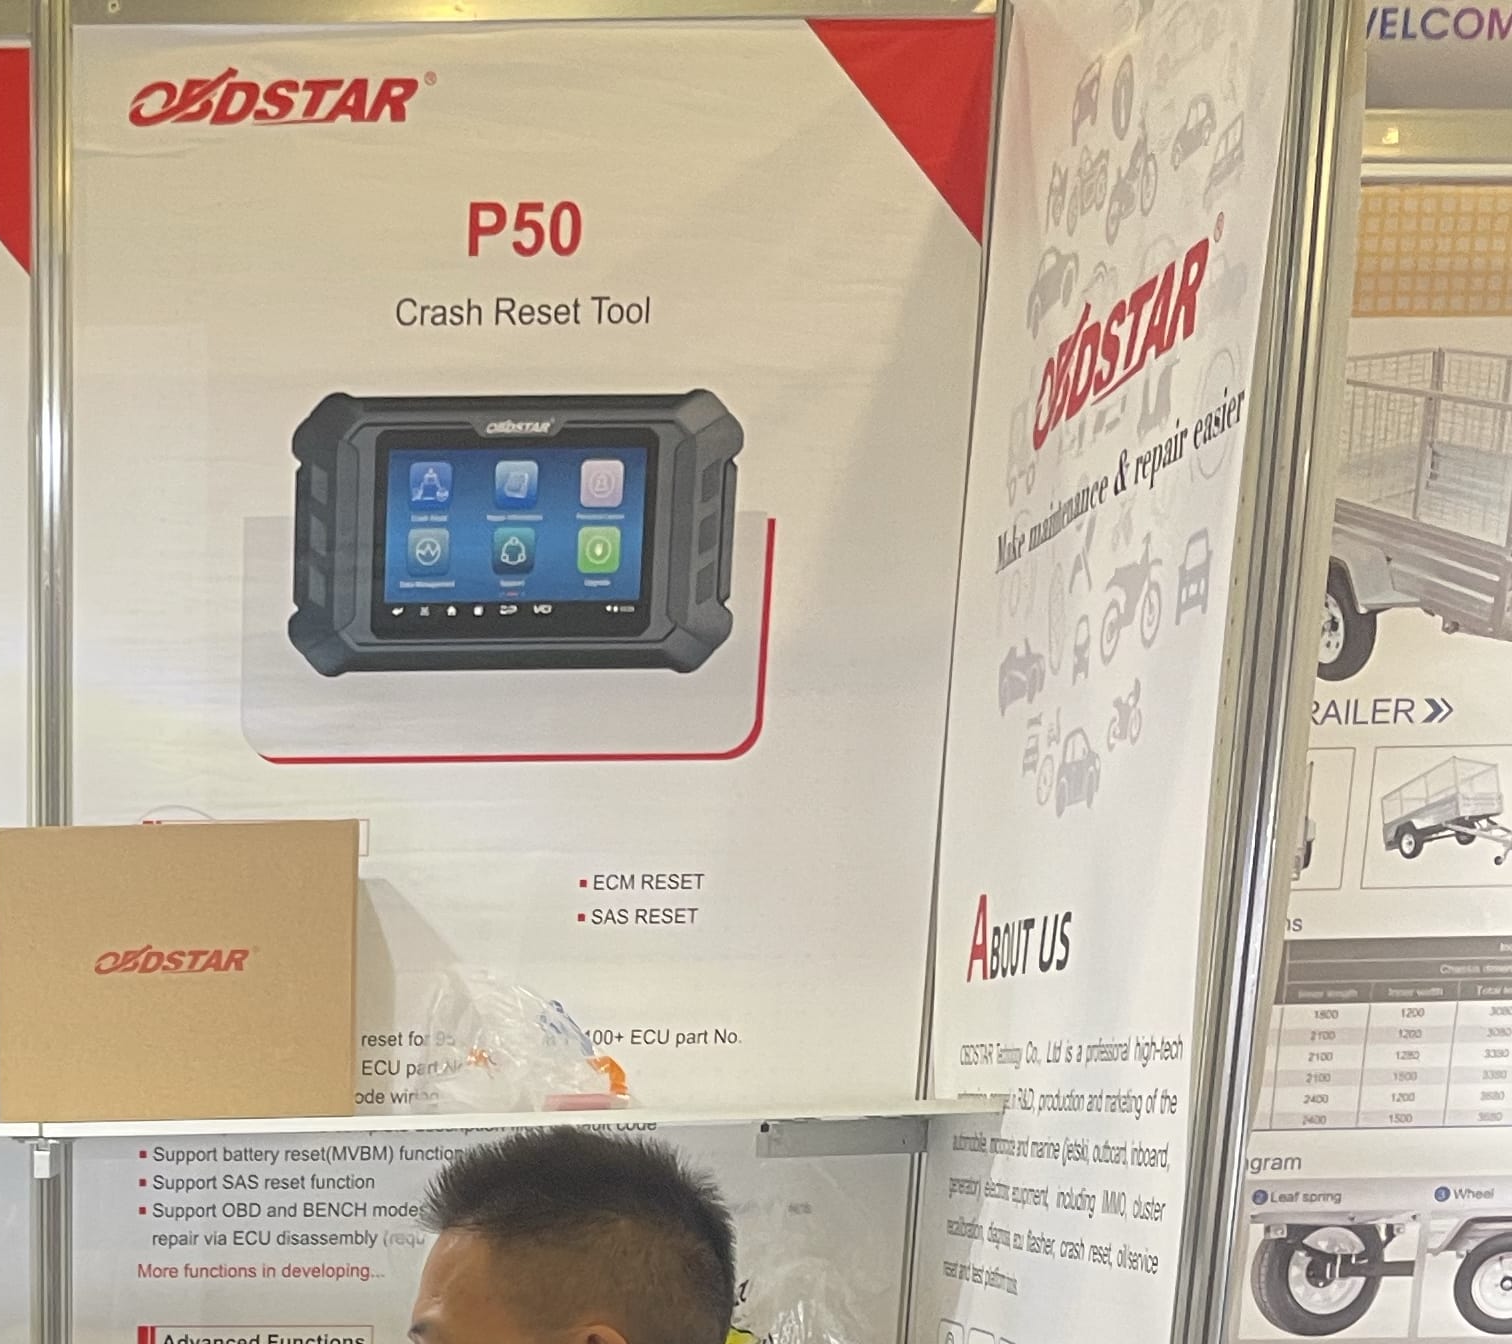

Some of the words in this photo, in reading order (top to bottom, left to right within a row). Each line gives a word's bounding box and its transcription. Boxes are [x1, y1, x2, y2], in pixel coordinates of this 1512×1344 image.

[128, 68, 417, 127] OBDSTAR
[1032, 237, 1209, 451] OBDSTAR
[995, 528, 1026, 574] Make
[1028, 476, 1108, 551] maintenance
[1113, 448, 1130, 493] &
[1133, 418, 1188, 490] repair
[1192, 387, 1246, 449] easier
[592, 872, 636, 891] ECM
[640, 872, 705, 891] RESET
[590, 907, 629, 925] SAS
[634, 907, 699, 925] RESET
[966, 893, 1036, 982] ABOUT
[1038, 911, 1072, 971] US
[94, 943, 249, 975] OBDSTAR
[359, 1030, 403, 1048] reset
[630, 1027, 670, 1045] ECU
[675, 1026, 709, 1048] part
[713, 1026, 742, 1045] No.
[1025, 1040, 1040, 1064] Co.,
[1046, 1040, 1062, 1063] Ltd
[1134, 1035, 1183, 1067] high-tech
[152, 1145, 218, 1166] Support
[222, 1145, 280, 1166] battery
[284, 1145, 395, 1166] reset(MVBM)
[399, 1145, 465, 1162] function
[152, 1173, 218, 1194] Support
[221, 1173, 260, 1190] SAS
[264, 1173, 306, 1190] reset
[310, 1172, 376, 1190] function
[1270, 1190, 1300, 1203] Leaf
[1302, 1191, 1342, 1204] spring
[1453, 1188, 1495, 1200] Wheel
[152, 1201, 217, 1221] Support
[221, 1201, 262, 1218] OBD
[266, 1200, 298, 1218] and
[302, 1200, 368, 1218] BENCH
[151, 1229, 200, 1249] repair
[203, 1229, 228, 1246] via
[232, 1229, 272, 1246] ECU
[275, 1229, 379, 1249] disassembly
[136, 1261, 178, 1278] More
[182, 1261, 261, 1278] functions
[259, 1261, 279, 1278] in
